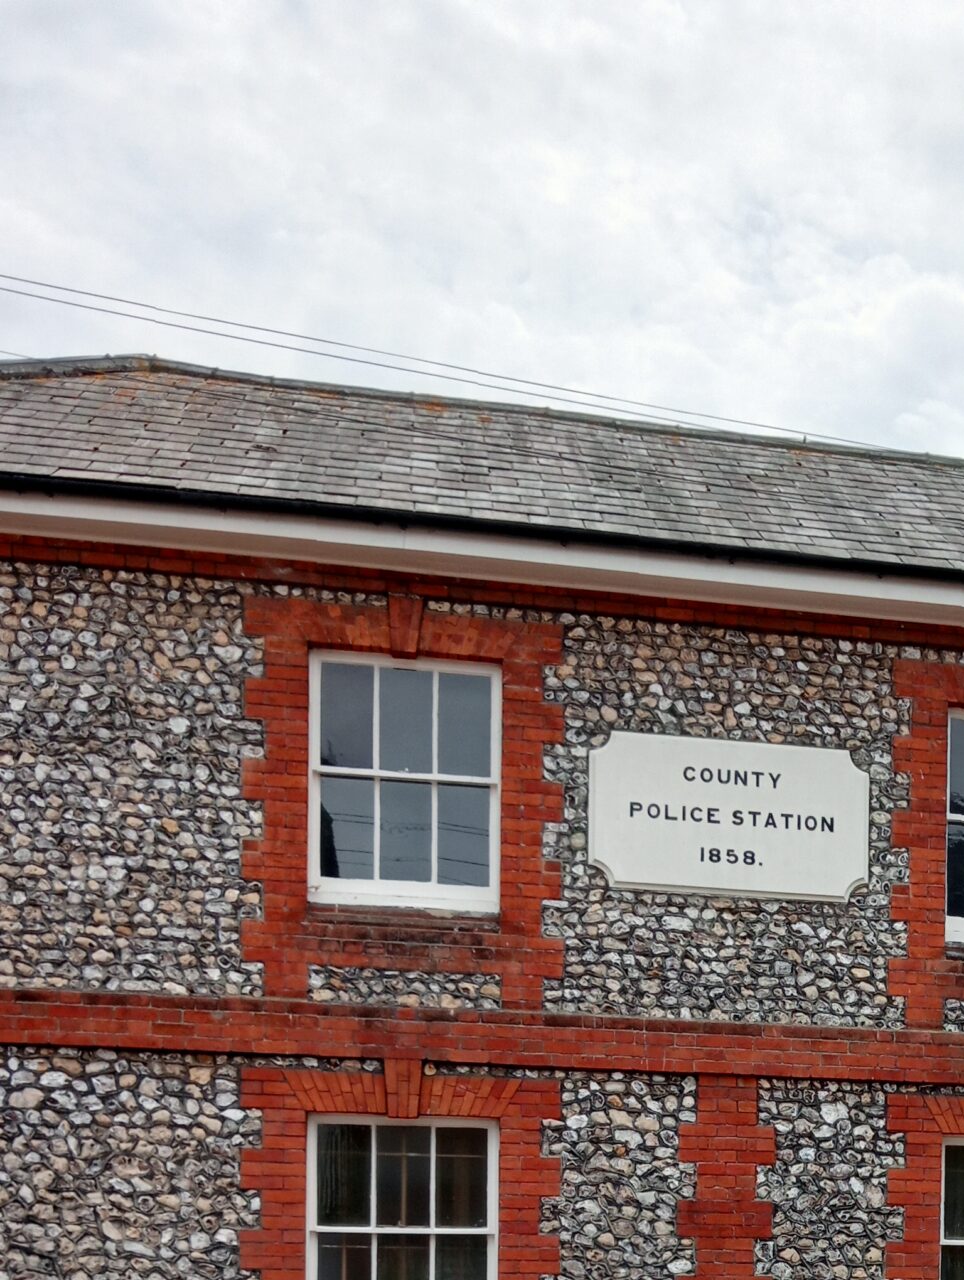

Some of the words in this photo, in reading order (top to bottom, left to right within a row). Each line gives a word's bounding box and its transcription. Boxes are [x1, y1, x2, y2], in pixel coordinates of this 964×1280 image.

[682, 766, 782, 789] COUNTY
[629, 801, 721, 825] POLICE
[731, 809, 835, 833] STATION
[700, 847, 763, 867] 1858.
